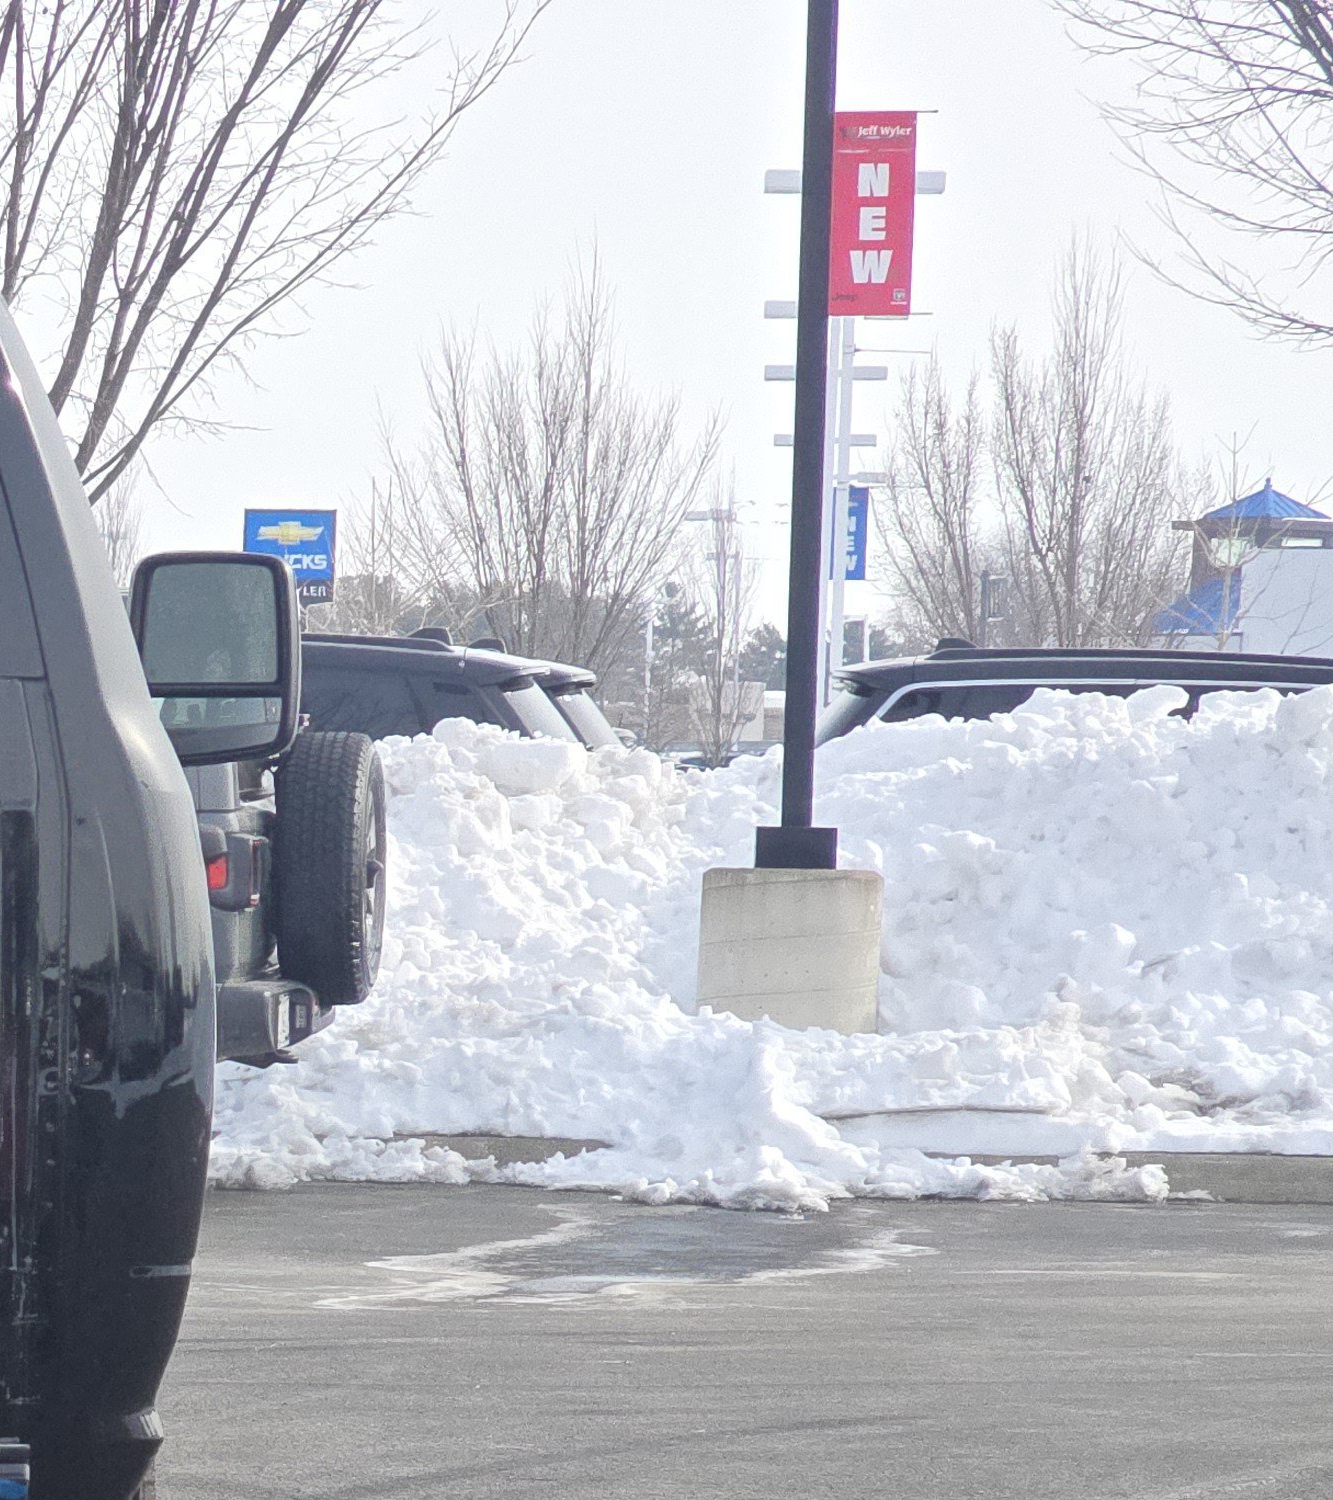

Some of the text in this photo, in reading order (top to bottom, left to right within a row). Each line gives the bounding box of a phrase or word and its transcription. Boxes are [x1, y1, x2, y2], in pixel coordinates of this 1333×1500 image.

[857, 125, 912, 139] Jeff Wyler
[849, 162, 893, 284] NEW
